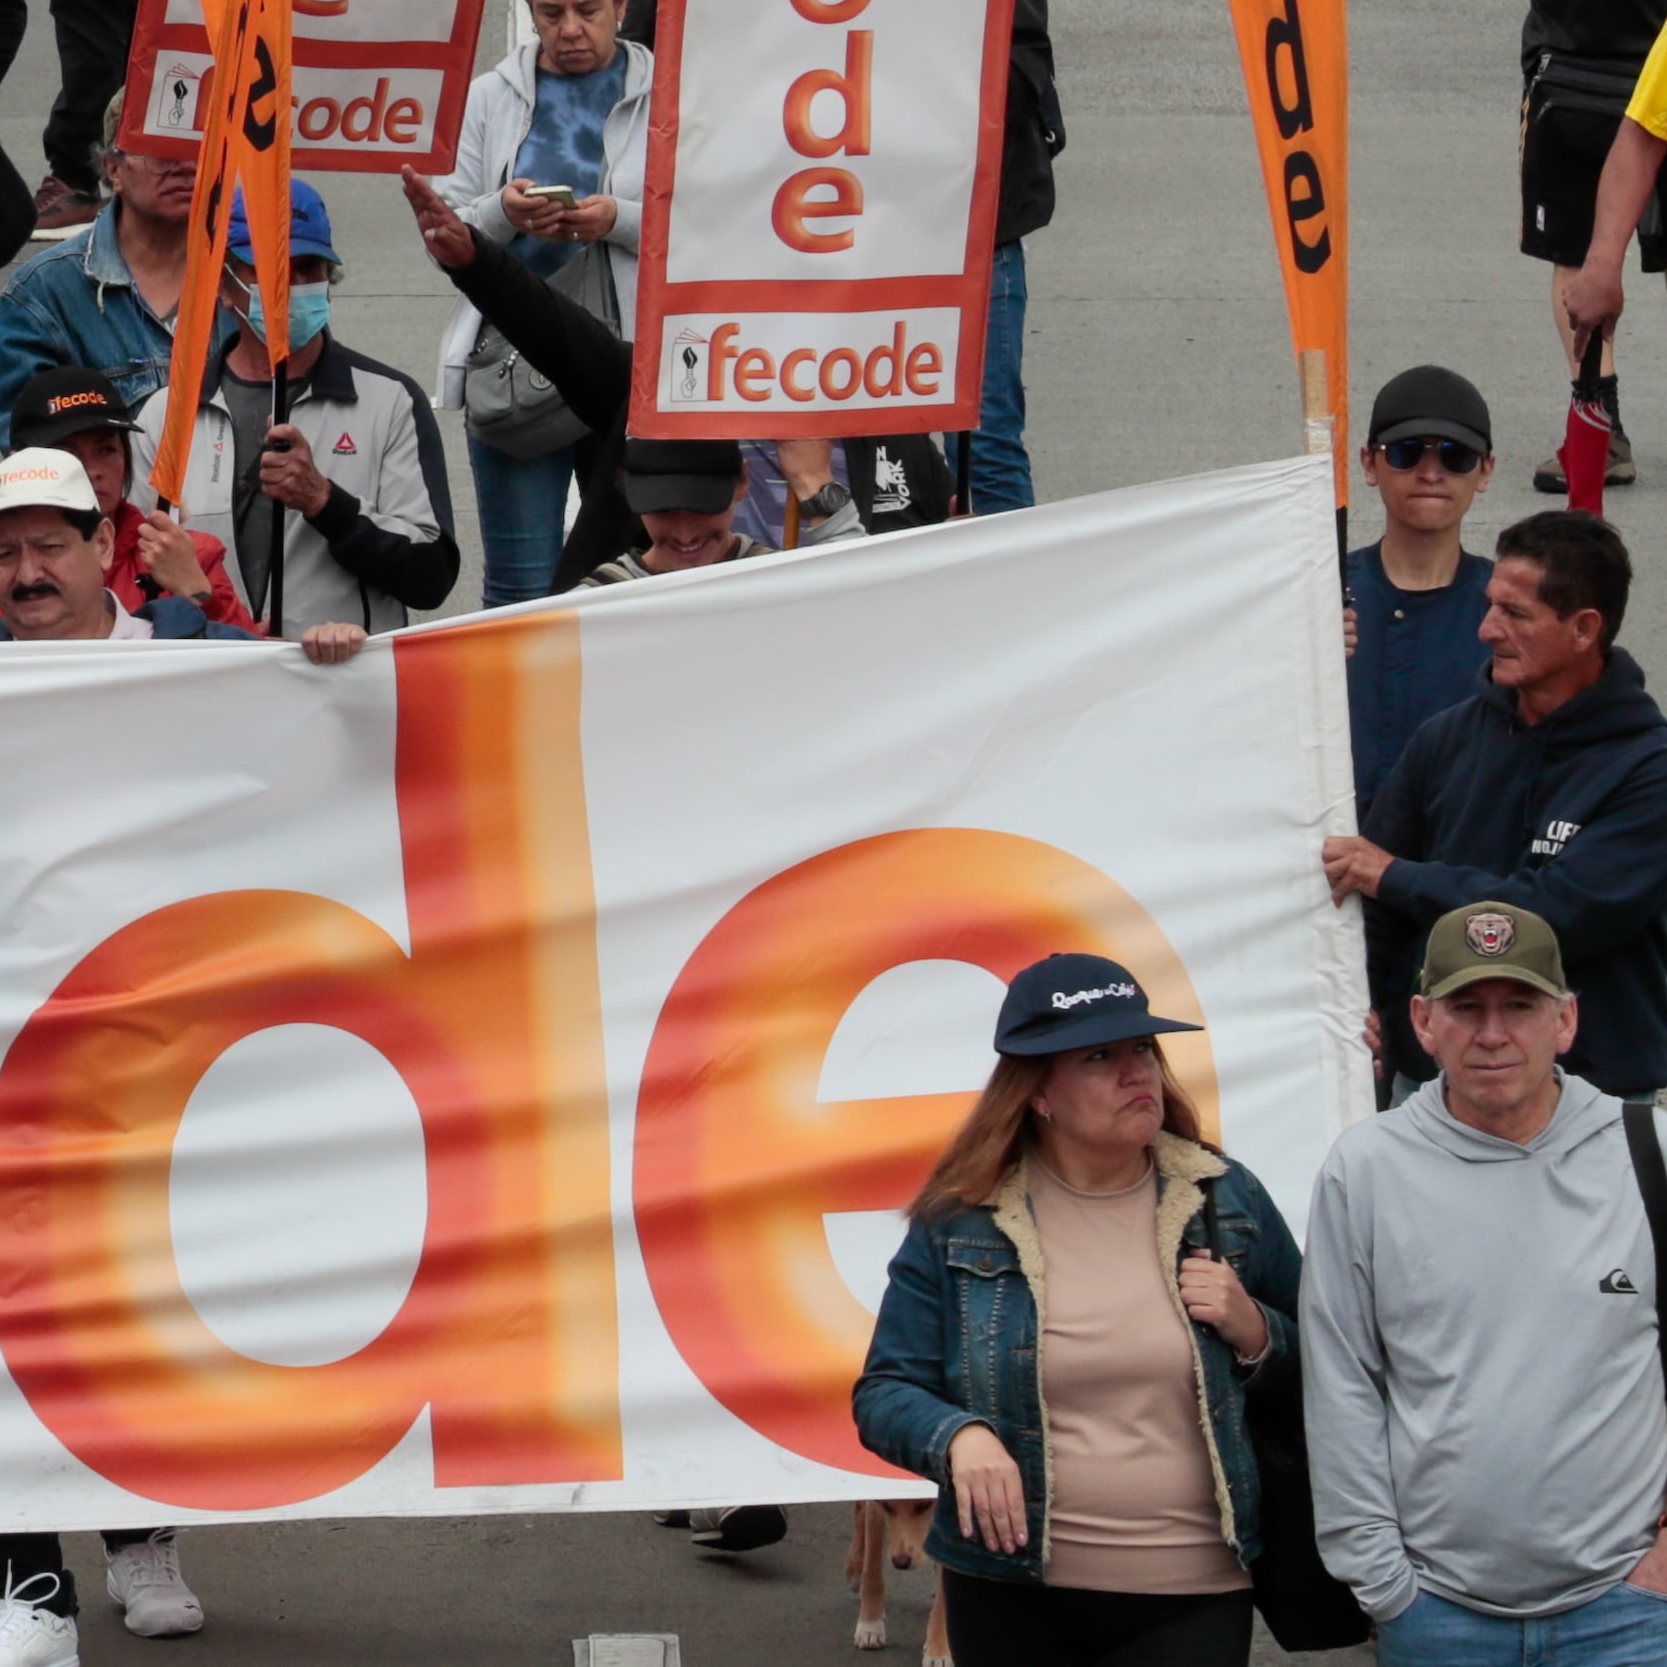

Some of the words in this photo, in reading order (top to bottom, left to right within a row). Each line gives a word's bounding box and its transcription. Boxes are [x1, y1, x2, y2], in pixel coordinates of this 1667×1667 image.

[708, 320, 944, 403] fecode
[55, 391, 108, 412] fecode
[3, 466, 59, 486] fecode
